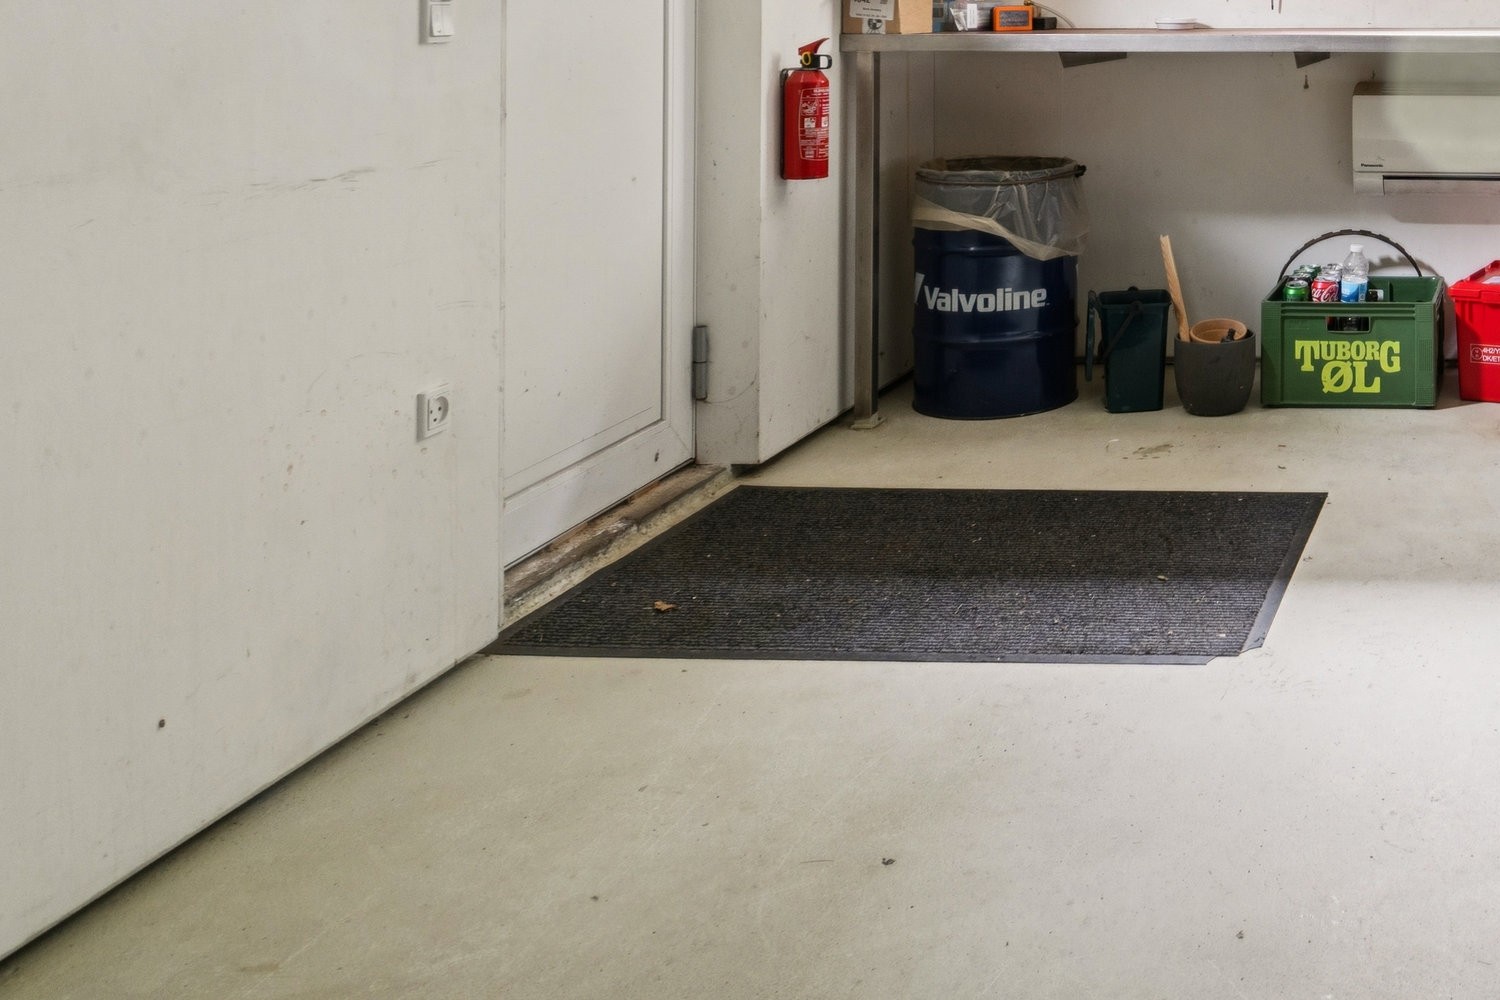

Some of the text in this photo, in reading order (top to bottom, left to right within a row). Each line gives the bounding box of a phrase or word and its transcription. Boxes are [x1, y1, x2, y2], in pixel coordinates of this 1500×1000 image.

[923, 285, 1048, 313] Valvoline
[1294, 339, 1401, 374] TUBORG
[1320, 360, 1381, 394] ØL
